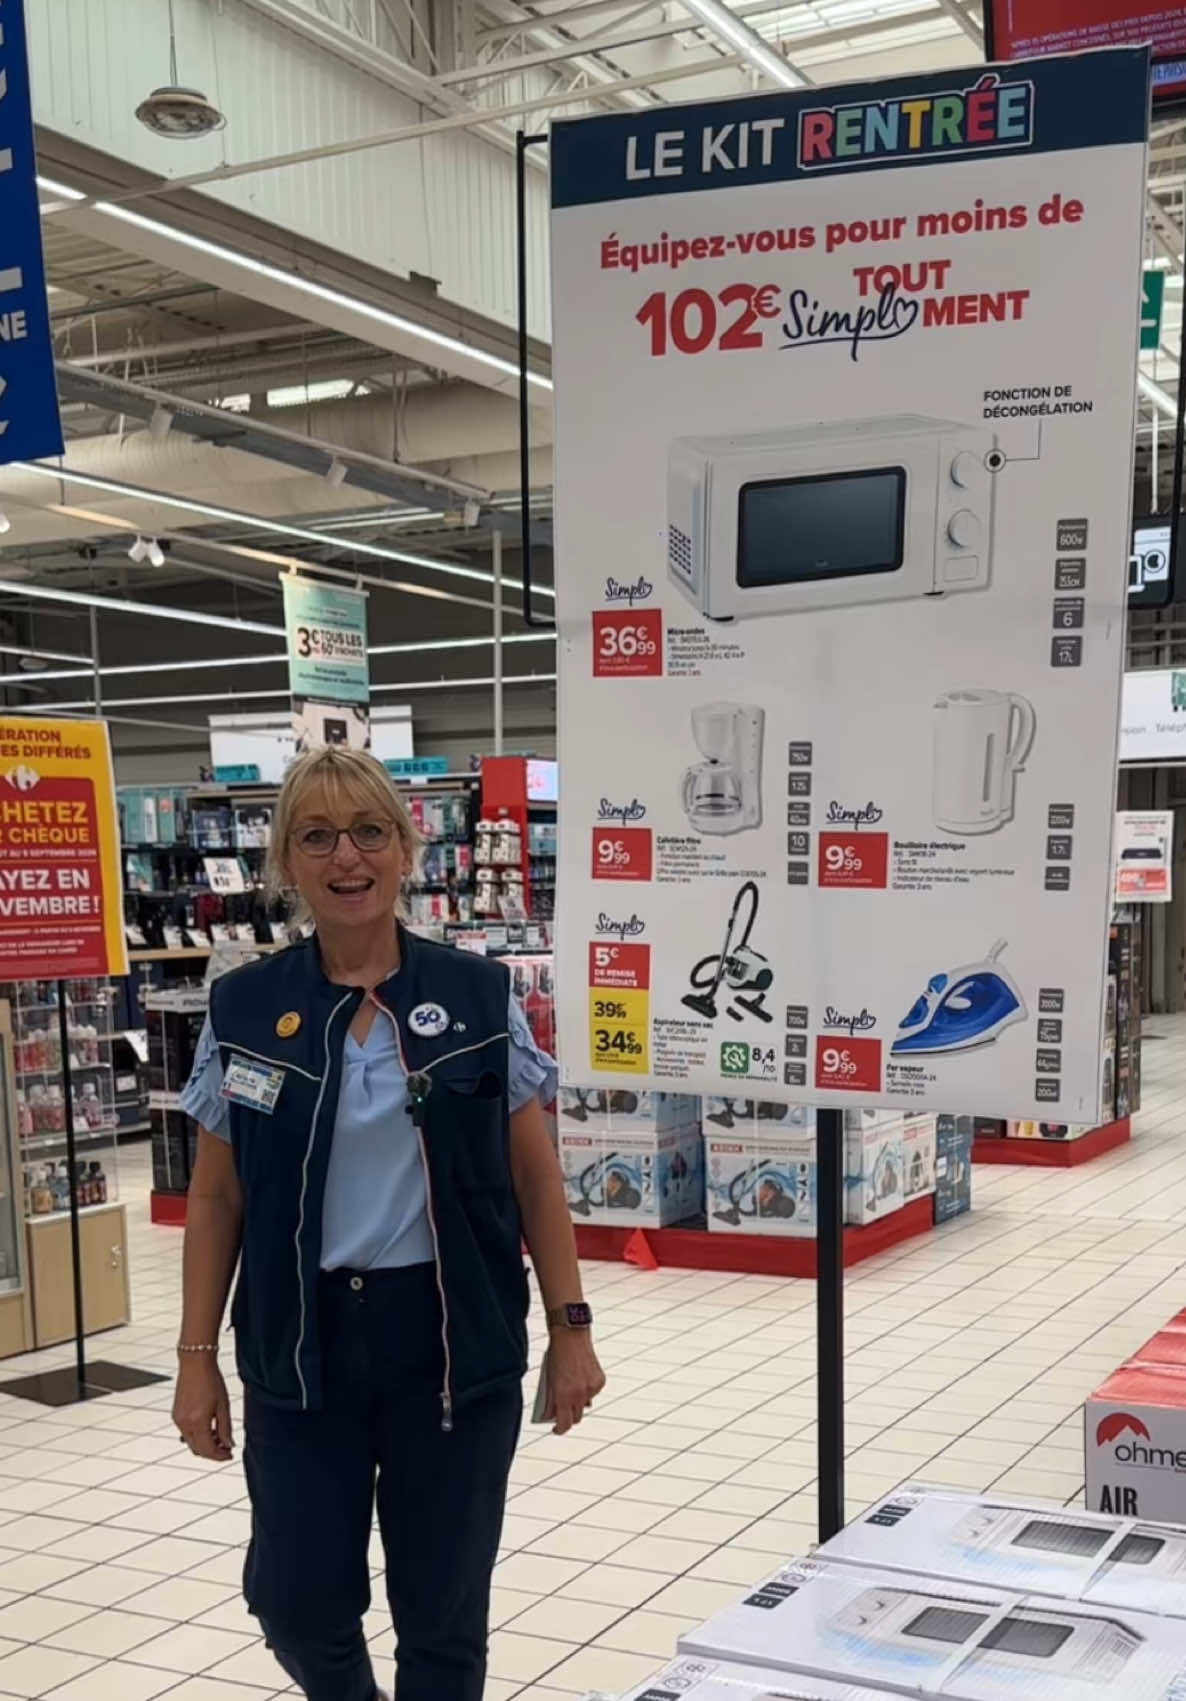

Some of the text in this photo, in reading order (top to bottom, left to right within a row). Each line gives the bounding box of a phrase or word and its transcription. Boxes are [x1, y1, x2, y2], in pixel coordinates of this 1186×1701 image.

[626, 76, 1026, 180] LE KIT RENTRÉE
[600, 193, 1084, 272] Équipez-vous pour moins de
[853, 259, 952, 296] TOUT
[923, 289, 1030, 327] MENT
[983, 385, 1072, 403] FONCTION DE
[983, 401, 1093, 419] DÉCONGÉLATION
[1063, 612, 1073, 626] 6
[23, 744, 91, 759] DIFFÉRÉS
[0, 801, 88, 823] HETEZ
[9, 825, 90, 844] CHÈQUE
[58, 868, 91, 890] EN
[752, 1047, 776, 1064] 8,4
[1115, 1441, 1186, 1469] ohme
[1100, 1485, 1139, 1516] AIR
